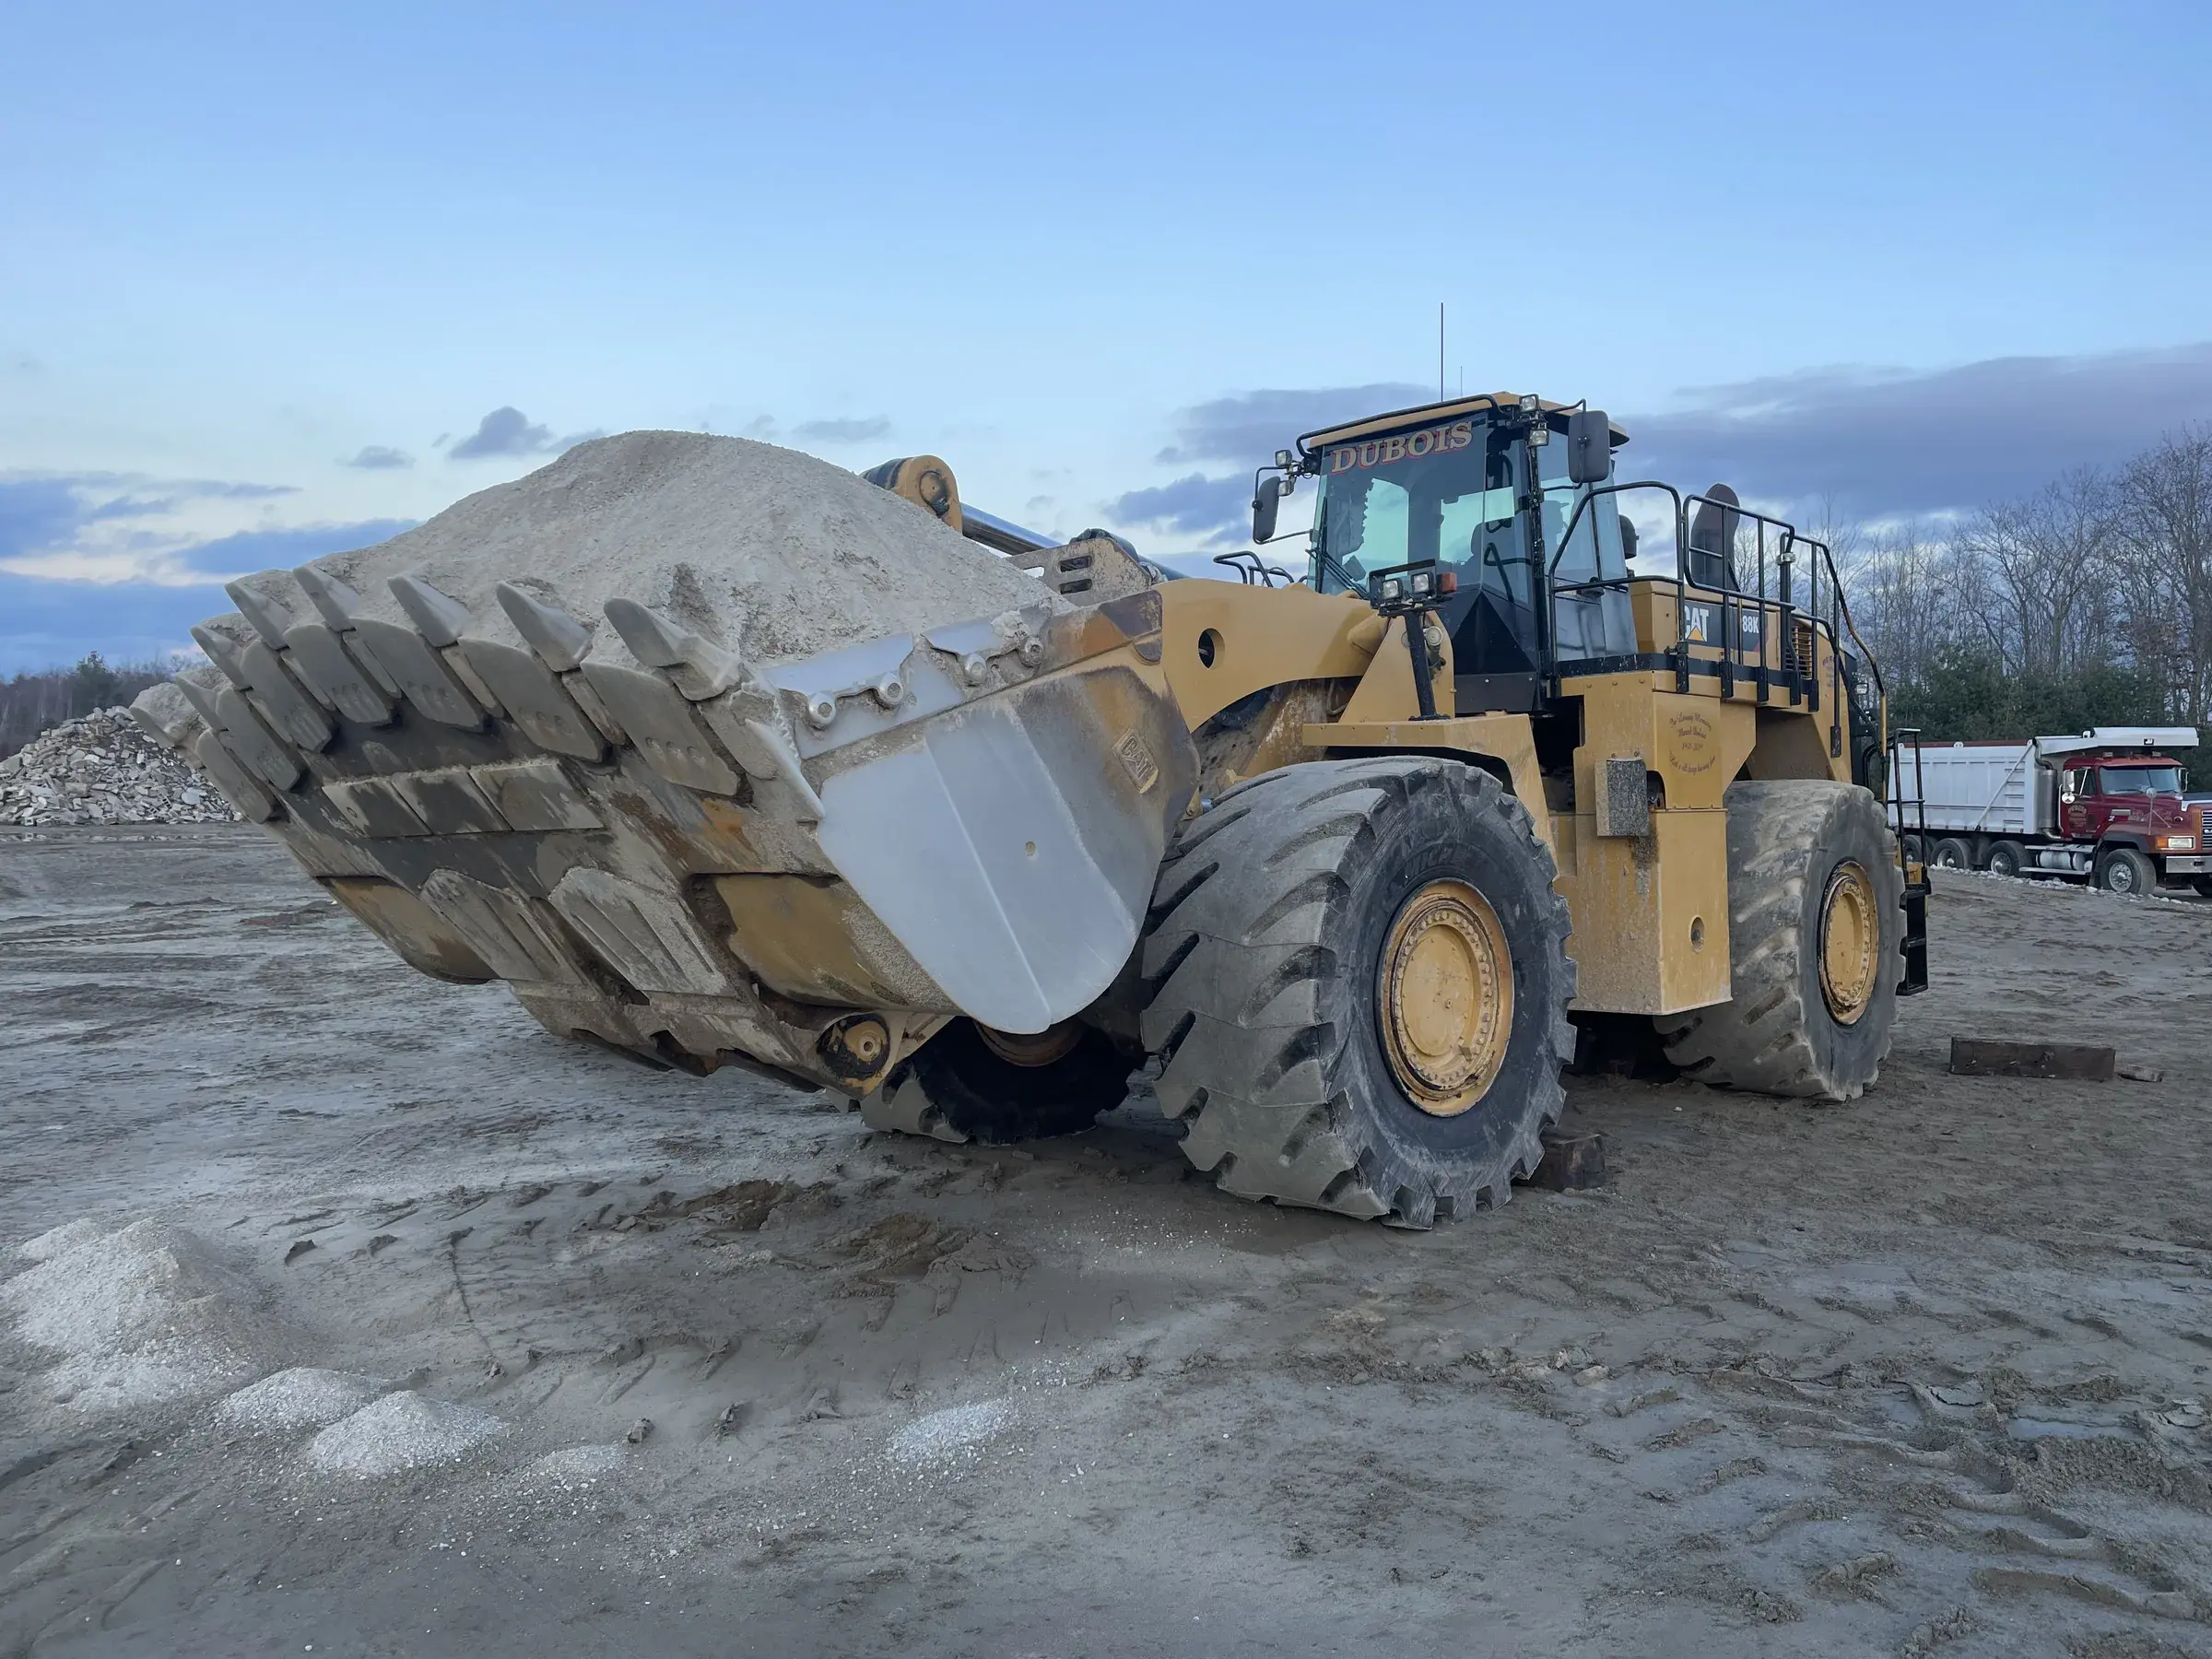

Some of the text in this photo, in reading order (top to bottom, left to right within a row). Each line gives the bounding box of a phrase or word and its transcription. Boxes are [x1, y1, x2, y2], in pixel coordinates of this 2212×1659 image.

[1331, 420, 1473, 475] DUBOIS
[1742, 614, 1759, 633] 88K
[1121, 735, 1154, 780] CAT
